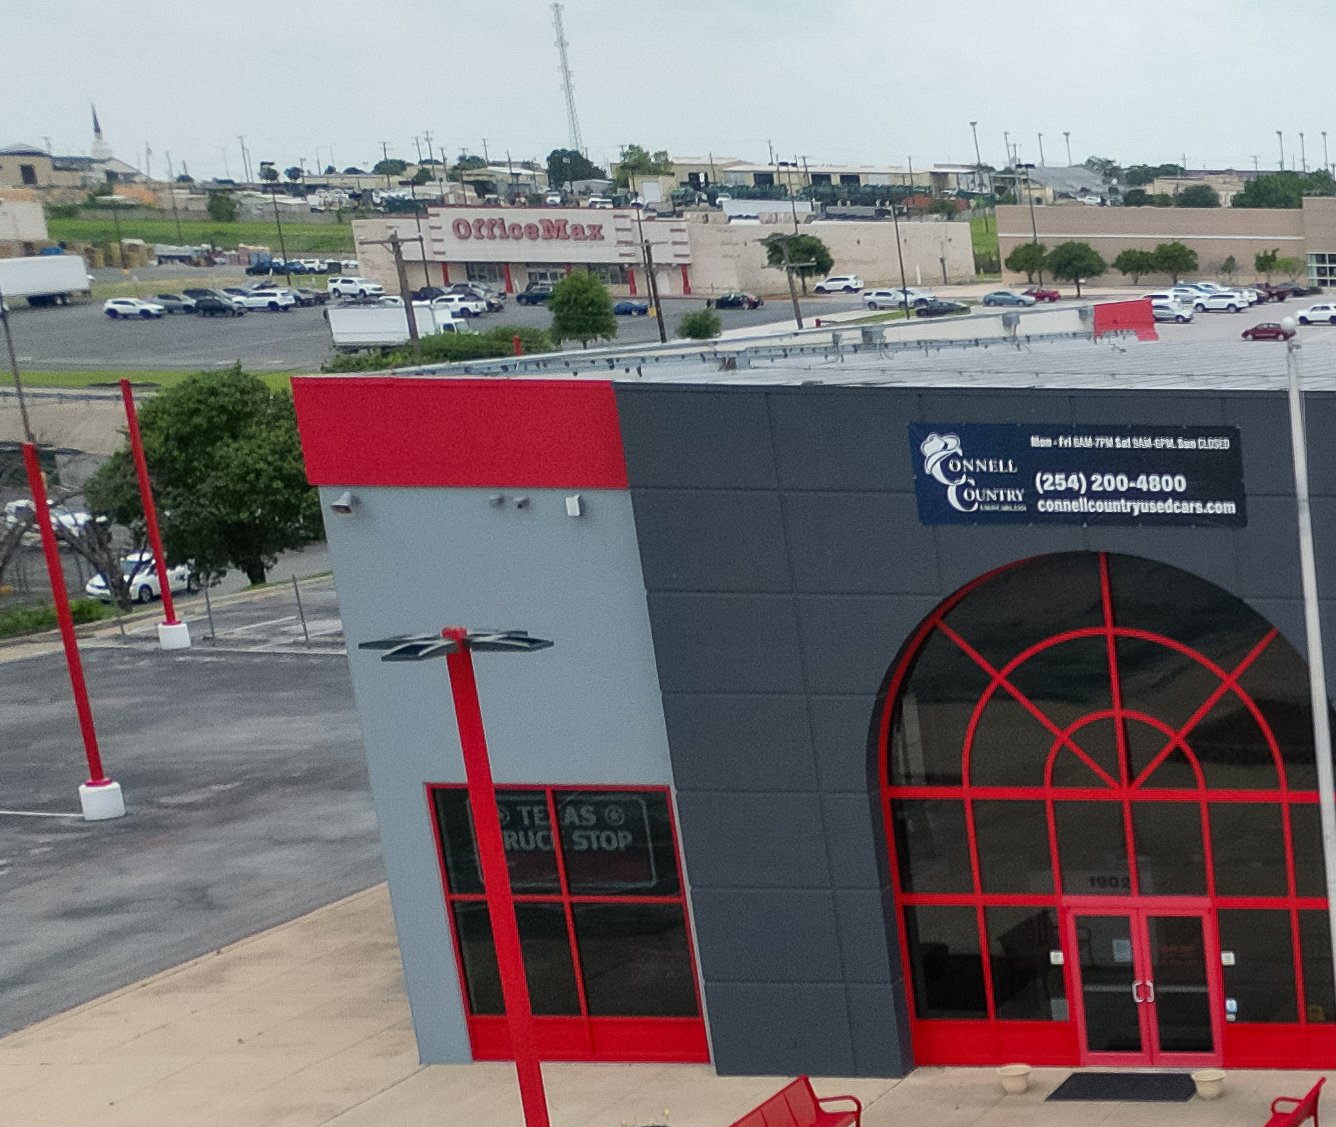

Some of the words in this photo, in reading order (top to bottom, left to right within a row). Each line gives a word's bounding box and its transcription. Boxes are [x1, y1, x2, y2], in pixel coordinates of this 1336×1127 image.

[452, 217, 604, 240] OfficeMax
[931, 449, 1018, 485] CONNELL
[947, 477, 1025, 512] COUNTRY
[1035, 471, 1087, 495] (254)
[1090, 473, 1187, 493] 200-4800
[1037, 497, 1236, 516] connellcountryusedcars.com
[517, 805, 597, 826] TEAS
[503, 830, 568, 851] RUC
[572, 830, 633, 851] STOP
